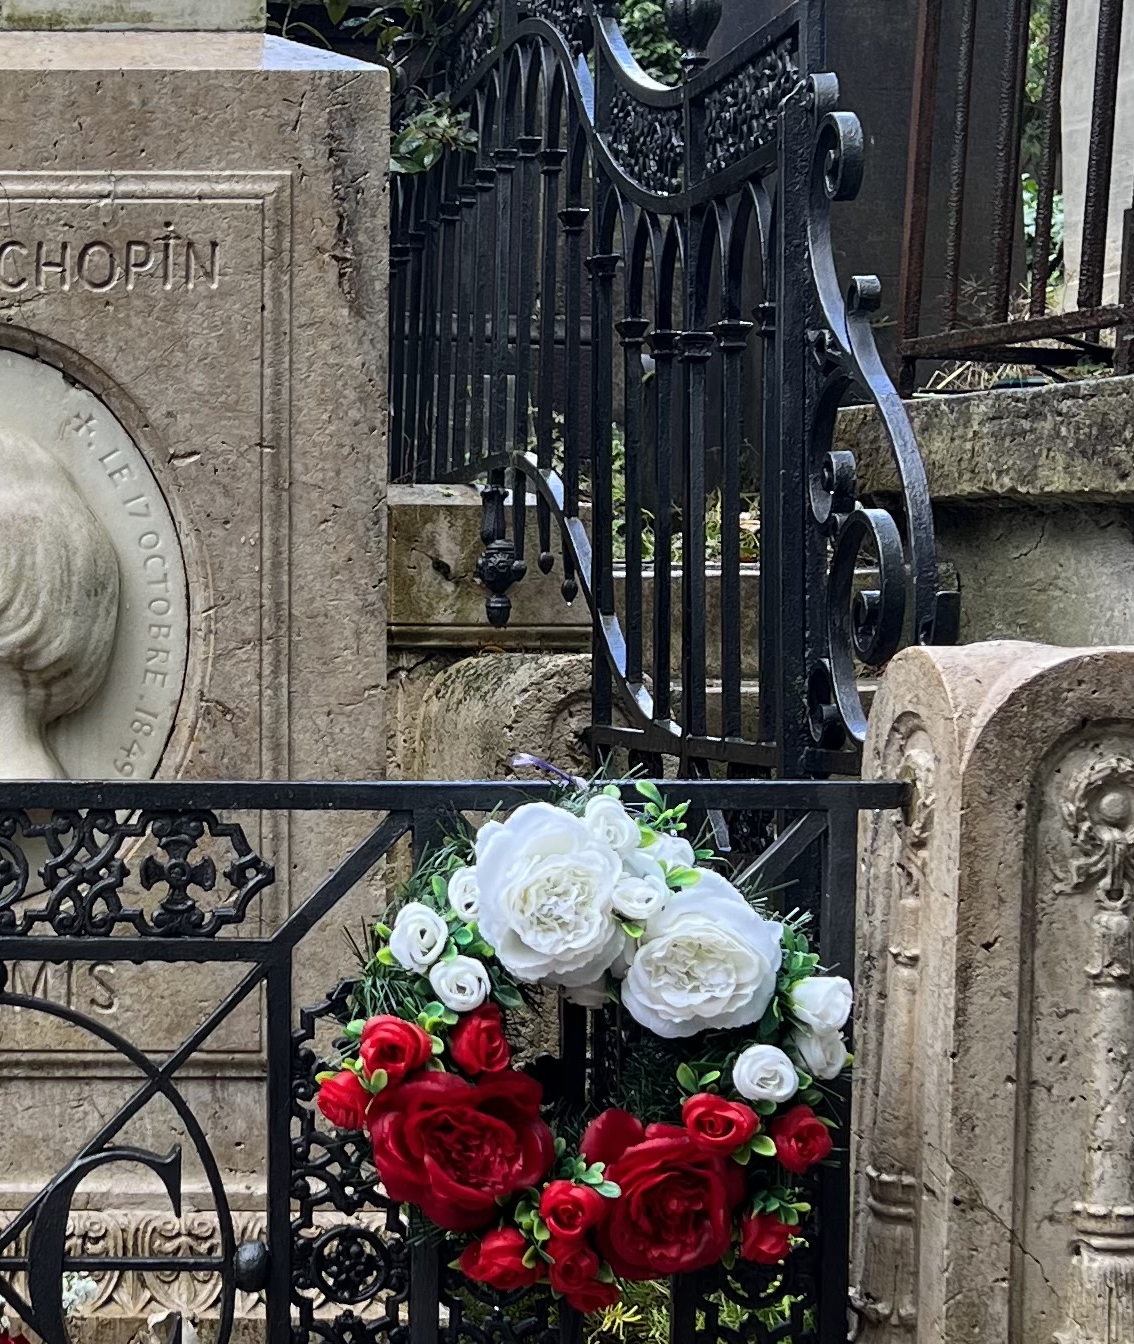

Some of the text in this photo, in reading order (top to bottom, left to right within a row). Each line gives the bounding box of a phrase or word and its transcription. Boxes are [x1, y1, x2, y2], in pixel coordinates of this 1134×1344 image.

[97, 447, 140, 491] LE
[121, 494, 152, 519] 17
[112, 705, 159, 778] 1849
